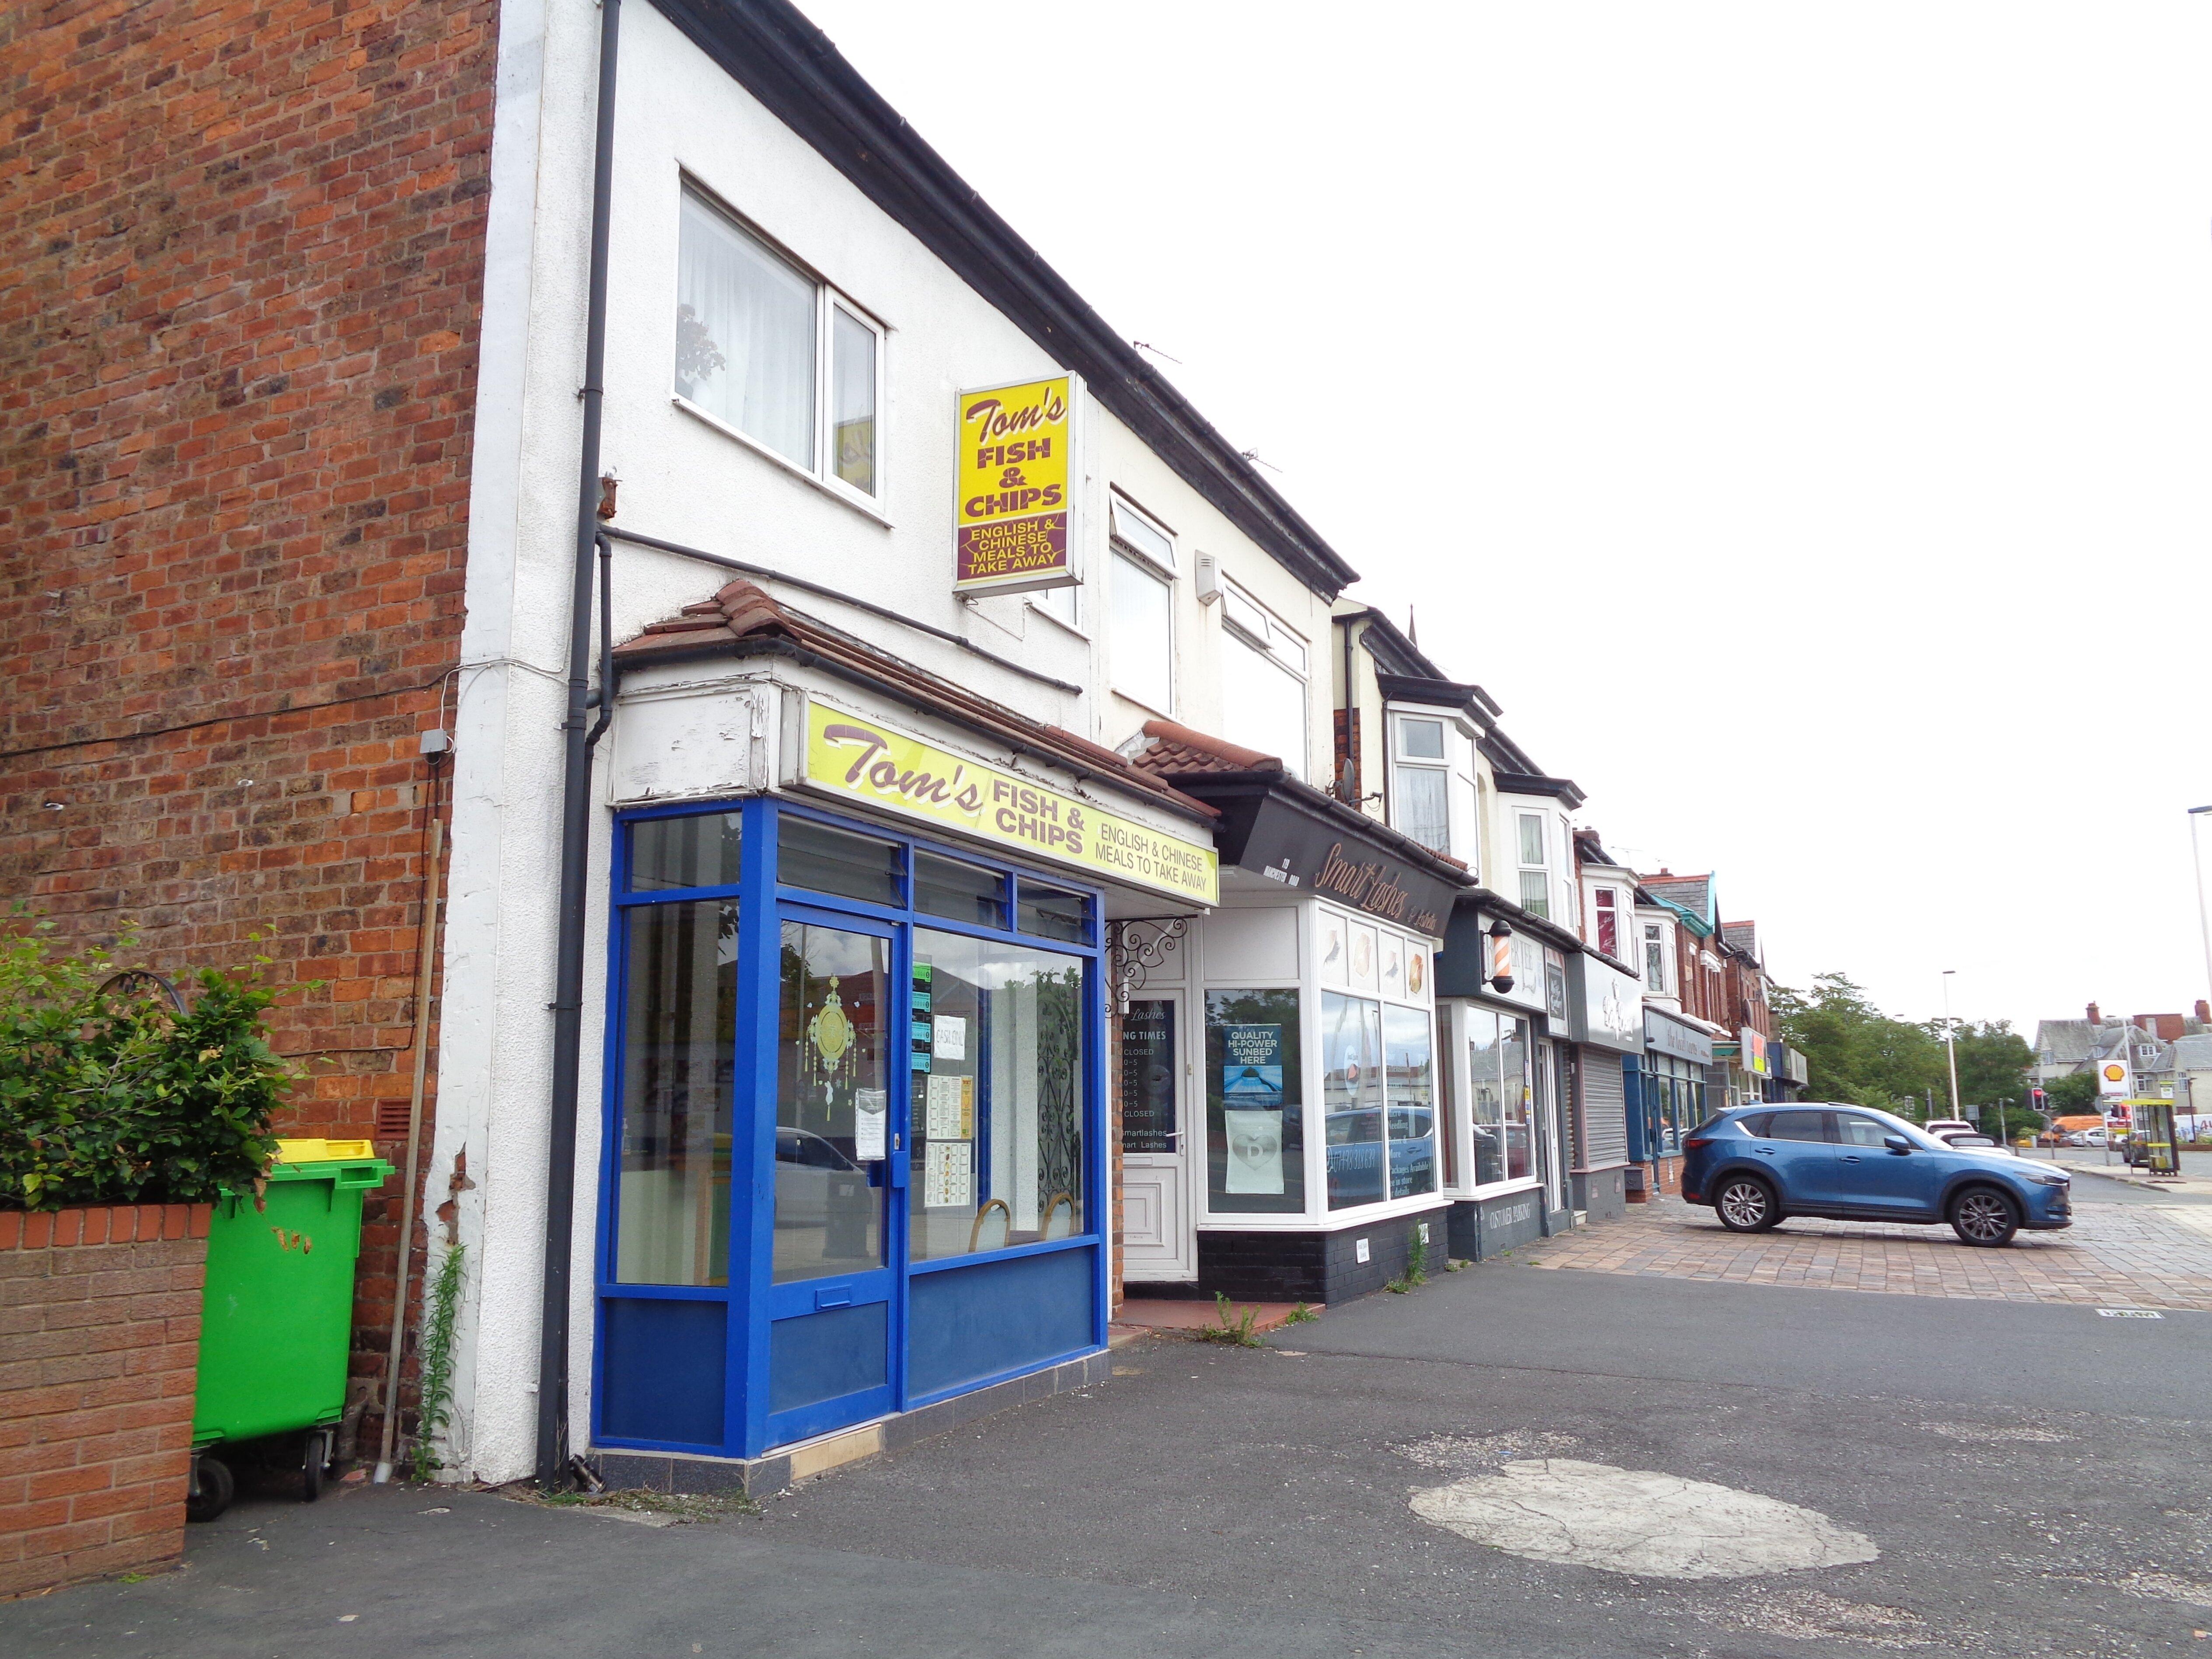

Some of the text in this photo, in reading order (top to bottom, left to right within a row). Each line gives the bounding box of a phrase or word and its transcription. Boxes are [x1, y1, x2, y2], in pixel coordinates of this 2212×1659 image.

[966, 387, 1067, 444] Tom's
[977, 437, 1050, 469] FISH
[999, 467, 1027, 488] &
[965, 484, 1062, 517] CHIPS
[971, 519, 1055, 540] ENGLISH &
[979, 531, 1047, 551] CHINESE
[973, 542, 1051, 562] MEALS TO
[969, 554, 1057, 575] TAKE AWAY
[823, 724, 984, 815] Tom's
[994, 779, 1085, 832] FISH &
[996, 808, 1083, 854] CHIPS
[1101, 823, 1202, 873] ENGLISH & CHINESE
[1096, 842, 1207, 892] MEALS TO TAKE AWAY
[1315, 843, 1408, 919] Smart Lashes
[1130, 1007, 1165, 1021] Lashes
[936, 1029, 950, 1044] CASH
[1139, 1031, 1166, 1040] TIMES
[1228, 1039, 1277, 1048] HI-POWER
[1231, 1031, 1273, 1040] QUALITY
[1247, 1143, 1263, 1161] D
[1410, 1161, 1430, 1173] Available)
[1395, 1186, 1410, 1196] details
[1396, 1177, 1400, 1185] in
[1490, 1207, 1512, 1229] CUSTOMER
[1513, 1202, 1530, 1223] PARKING
